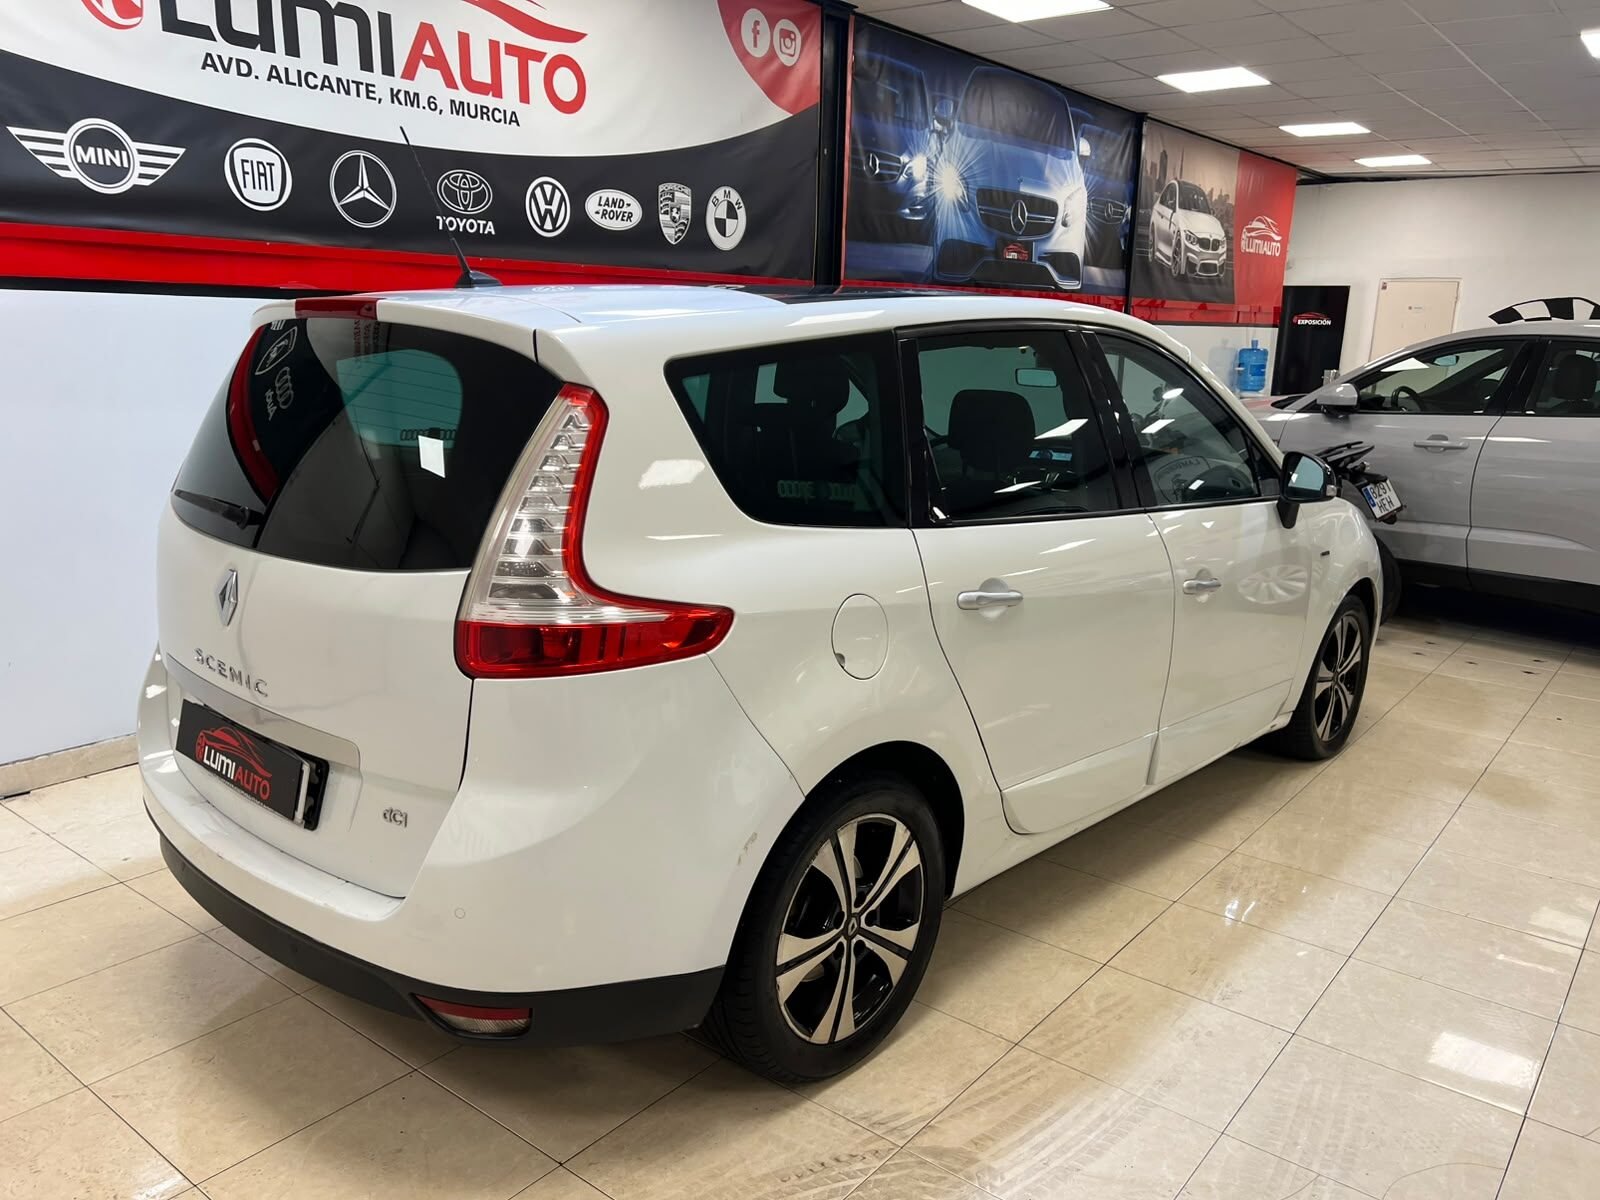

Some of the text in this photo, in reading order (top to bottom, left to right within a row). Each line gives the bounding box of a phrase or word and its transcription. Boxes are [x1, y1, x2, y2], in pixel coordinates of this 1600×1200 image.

[200, 52, 520, 127] AVD. ALICANTE, KM.6, MURCIA
[75, 145, 129, 168] MINI
[240, 158, 276, 191] FIAT
[711, 189, 743, 210] BMW
[436, 216, 495, 235] TOYOTA
[1297, 318, 1332, 326] EXPOSICIÓN
[194, 647, 268, 697] SCENIC
